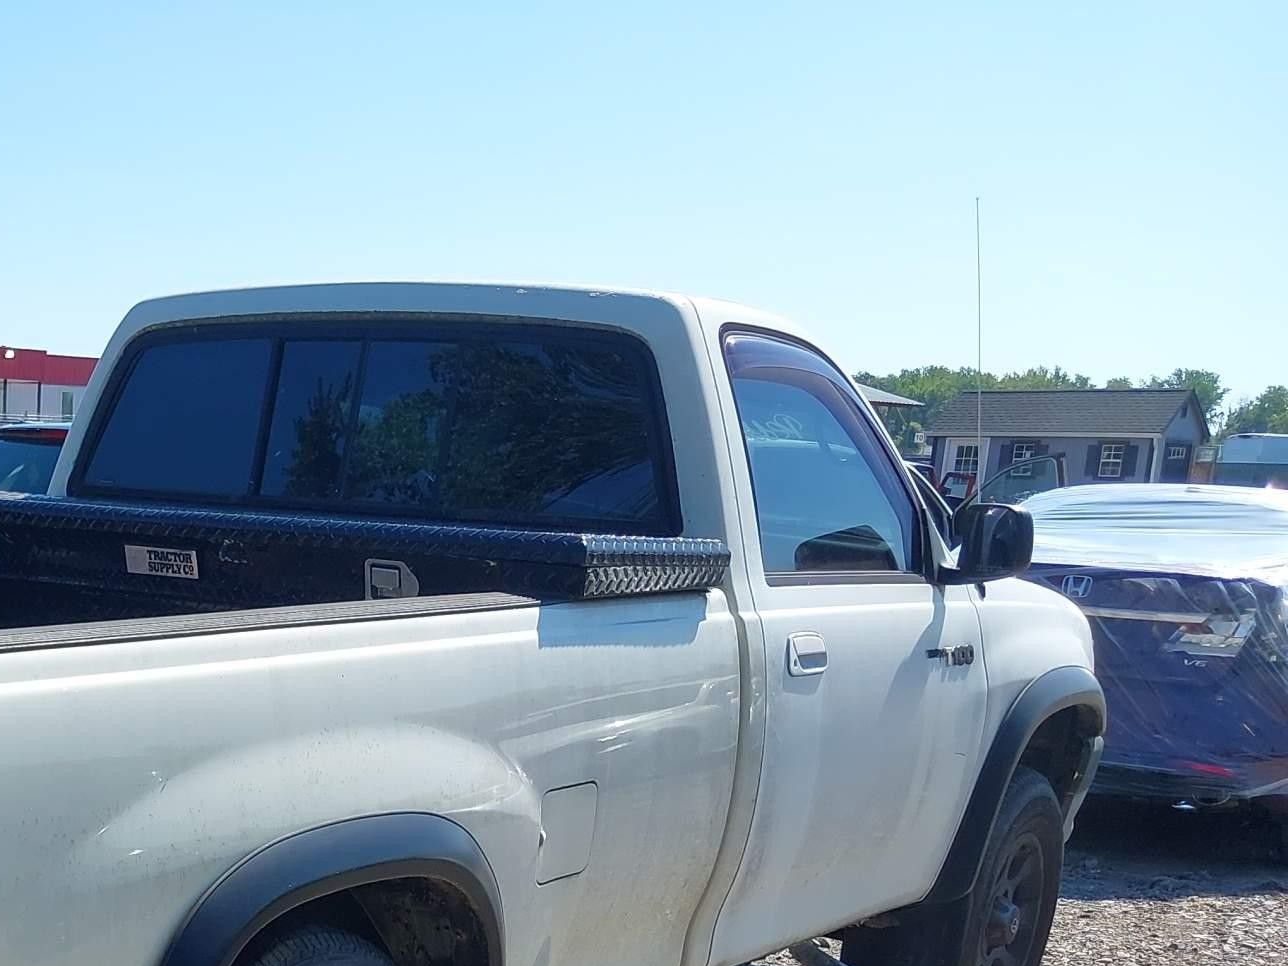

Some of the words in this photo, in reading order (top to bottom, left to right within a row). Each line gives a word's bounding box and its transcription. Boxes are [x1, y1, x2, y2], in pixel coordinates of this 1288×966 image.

[146, 550, 192, 564] TRACTOR
[148, 561, 182, 575] SUPPLY
[1184, 659, 1209, 667] V6
